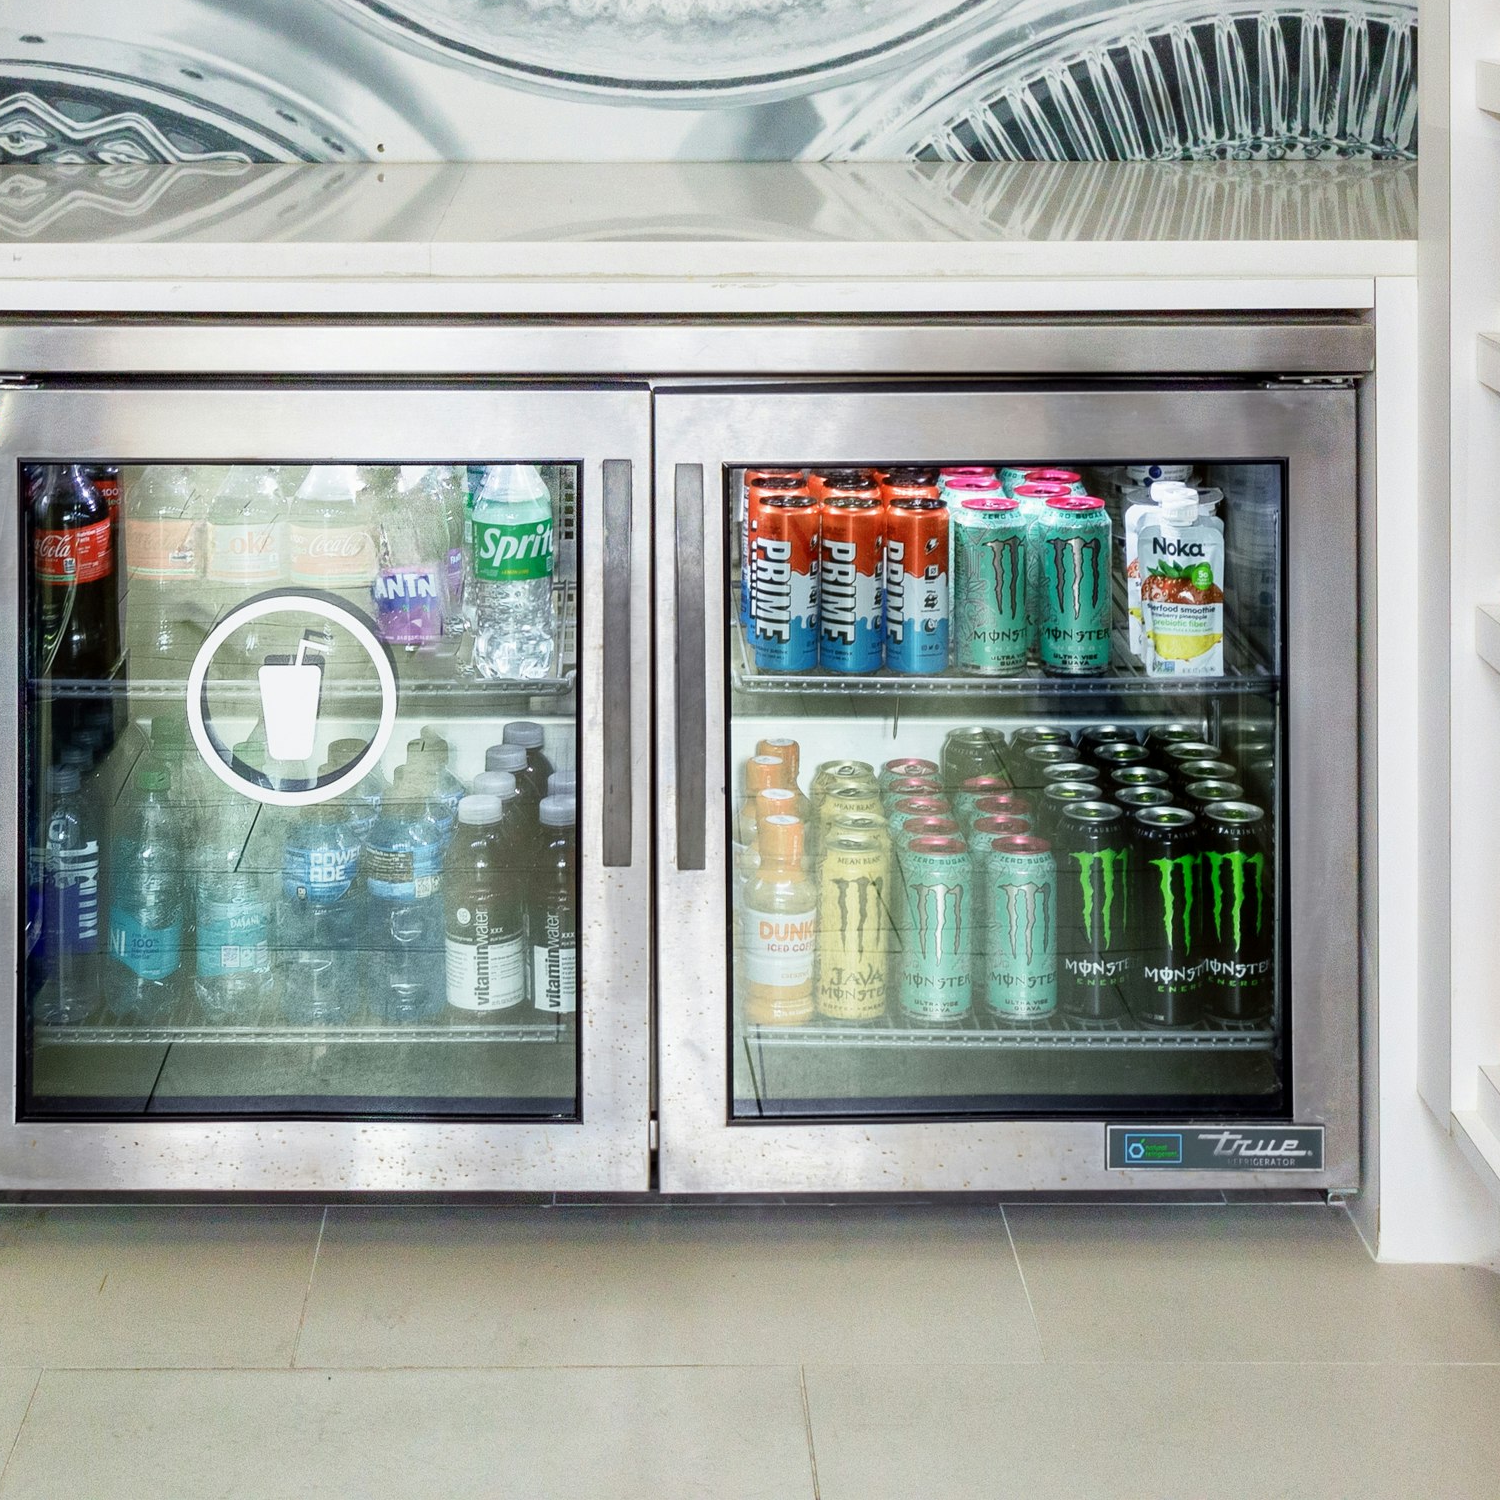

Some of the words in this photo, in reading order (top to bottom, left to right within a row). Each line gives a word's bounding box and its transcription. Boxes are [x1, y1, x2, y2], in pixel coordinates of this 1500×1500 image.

[479, 523, 553, 567] Sprit
[1152, 537, 1205, 557] Noka
[756, 537, 792, 644] PRIME
[821, 539, 856, 645] PRIME
[1179, 612, 1207, 621] pineapple
[1180, 605, 1215, 614] smoothie
[1153, 619, 1187, 628] prebiotic
[1189, 619, 1206, 627] fiber
[837, 856, 863, 865] MEAN
[913, 856, 935, 865] ZERO
[1000, 855, 1022, 864] ZERO
[309, 867, 346, 883] ADE
[230, 914, 260, 929] DASANI
[767, 943, 790, 953] ICED
[474, 907, 490, 1006] vitaminwater
[545, 913, 560, 1009] vitaminwater
[830, 963, 884, 986] JAVA
[1198, 1131, 1306, 1156] true
[1227, 1158, 1296, 1166] REFRIGERATOR
